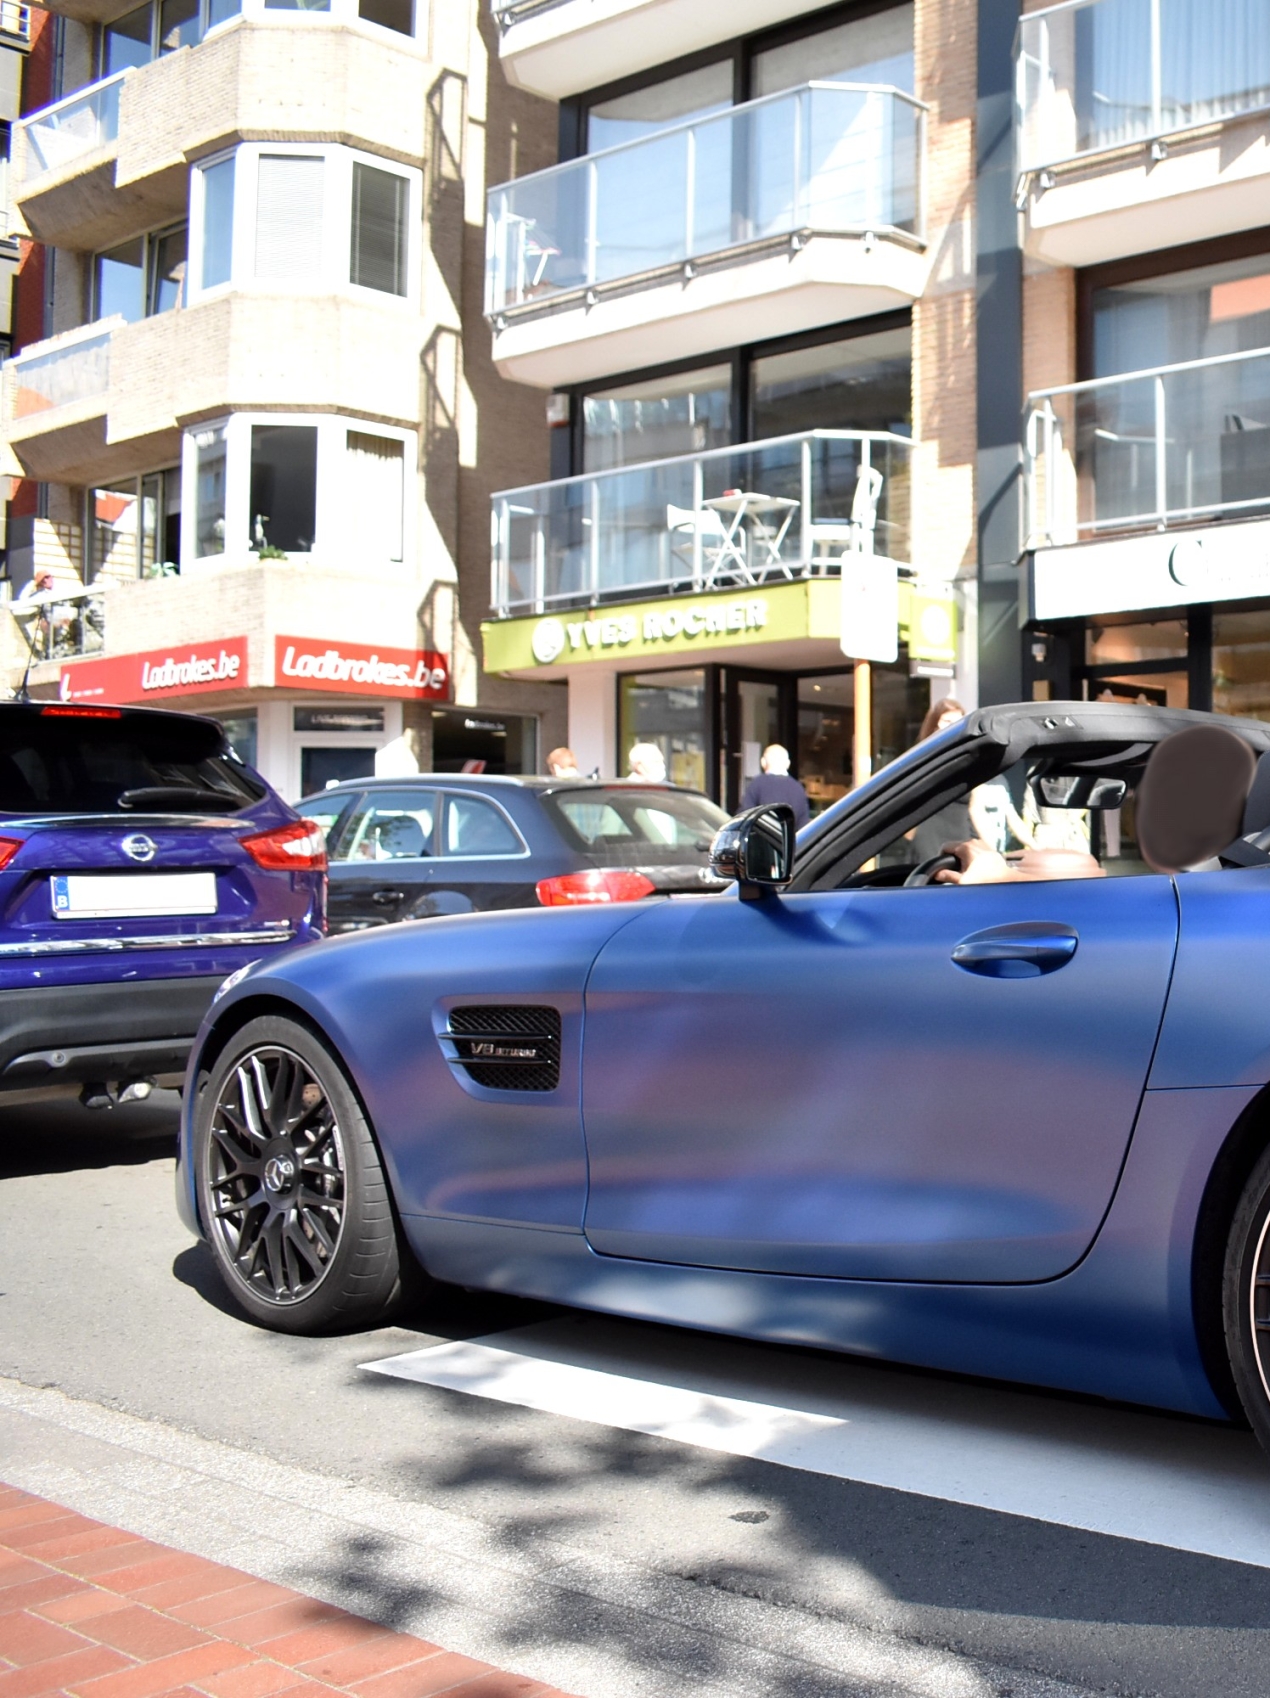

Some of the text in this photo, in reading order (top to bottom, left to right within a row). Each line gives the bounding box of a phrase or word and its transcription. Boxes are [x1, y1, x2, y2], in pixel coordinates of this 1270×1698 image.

[566, 598, 769, 649] YVES ROCHER
[141, 650, 241, 691] Ladbrokes.be
[281, 646, 447, 690] Ladbrokes.be
[57, 896, 69, 909] B
[471, 1042, 495, 1055] V8
